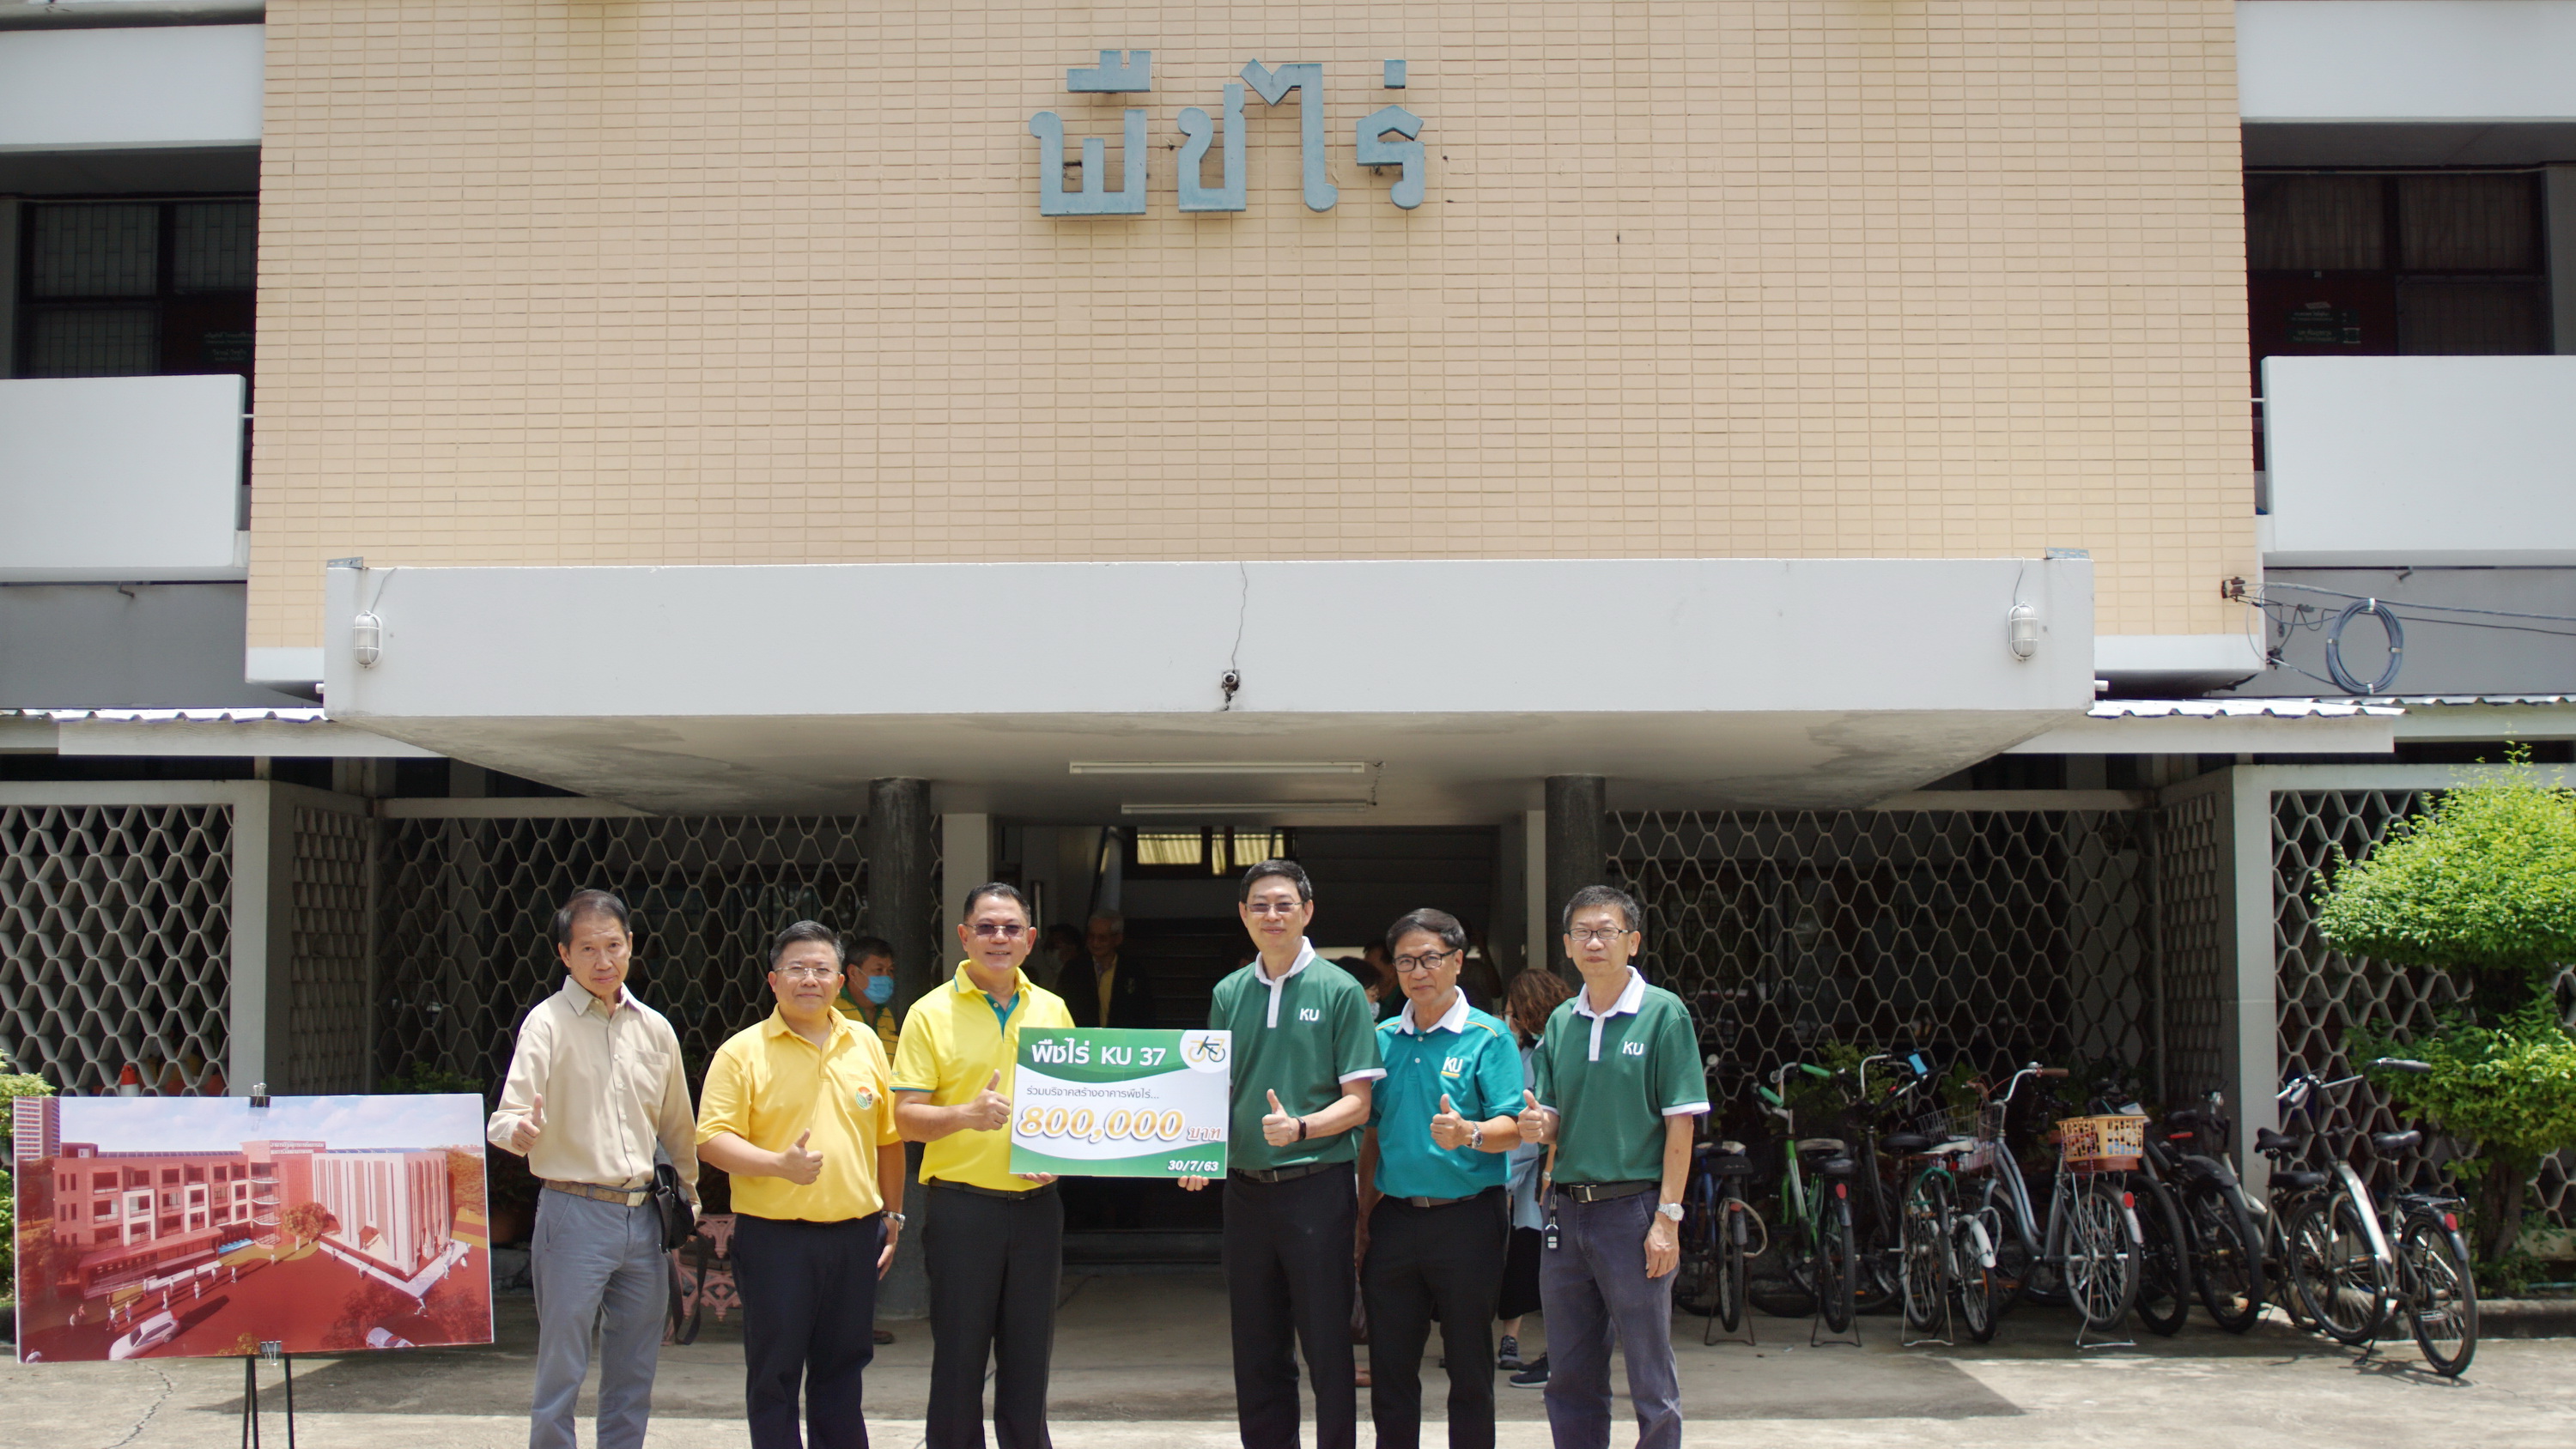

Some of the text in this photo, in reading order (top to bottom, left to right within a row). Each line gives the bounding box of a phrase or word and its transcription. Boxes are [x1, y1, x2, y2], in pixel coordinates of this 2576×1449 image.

[1029, 51, 1425, 216] พืชไร่
[1299, 1008, 1320, 1022] KU
[1031, 1037, 1166, 1066] พืชไร่ KU 37
[1622, 1040, 1644, 1056] KU
[1443, 1056, 1463, 1073] KU
[1018, 1104, 1222, 1143] 800,000 บาท
[1168, 1160, 1219, 1172] 30/7/63
